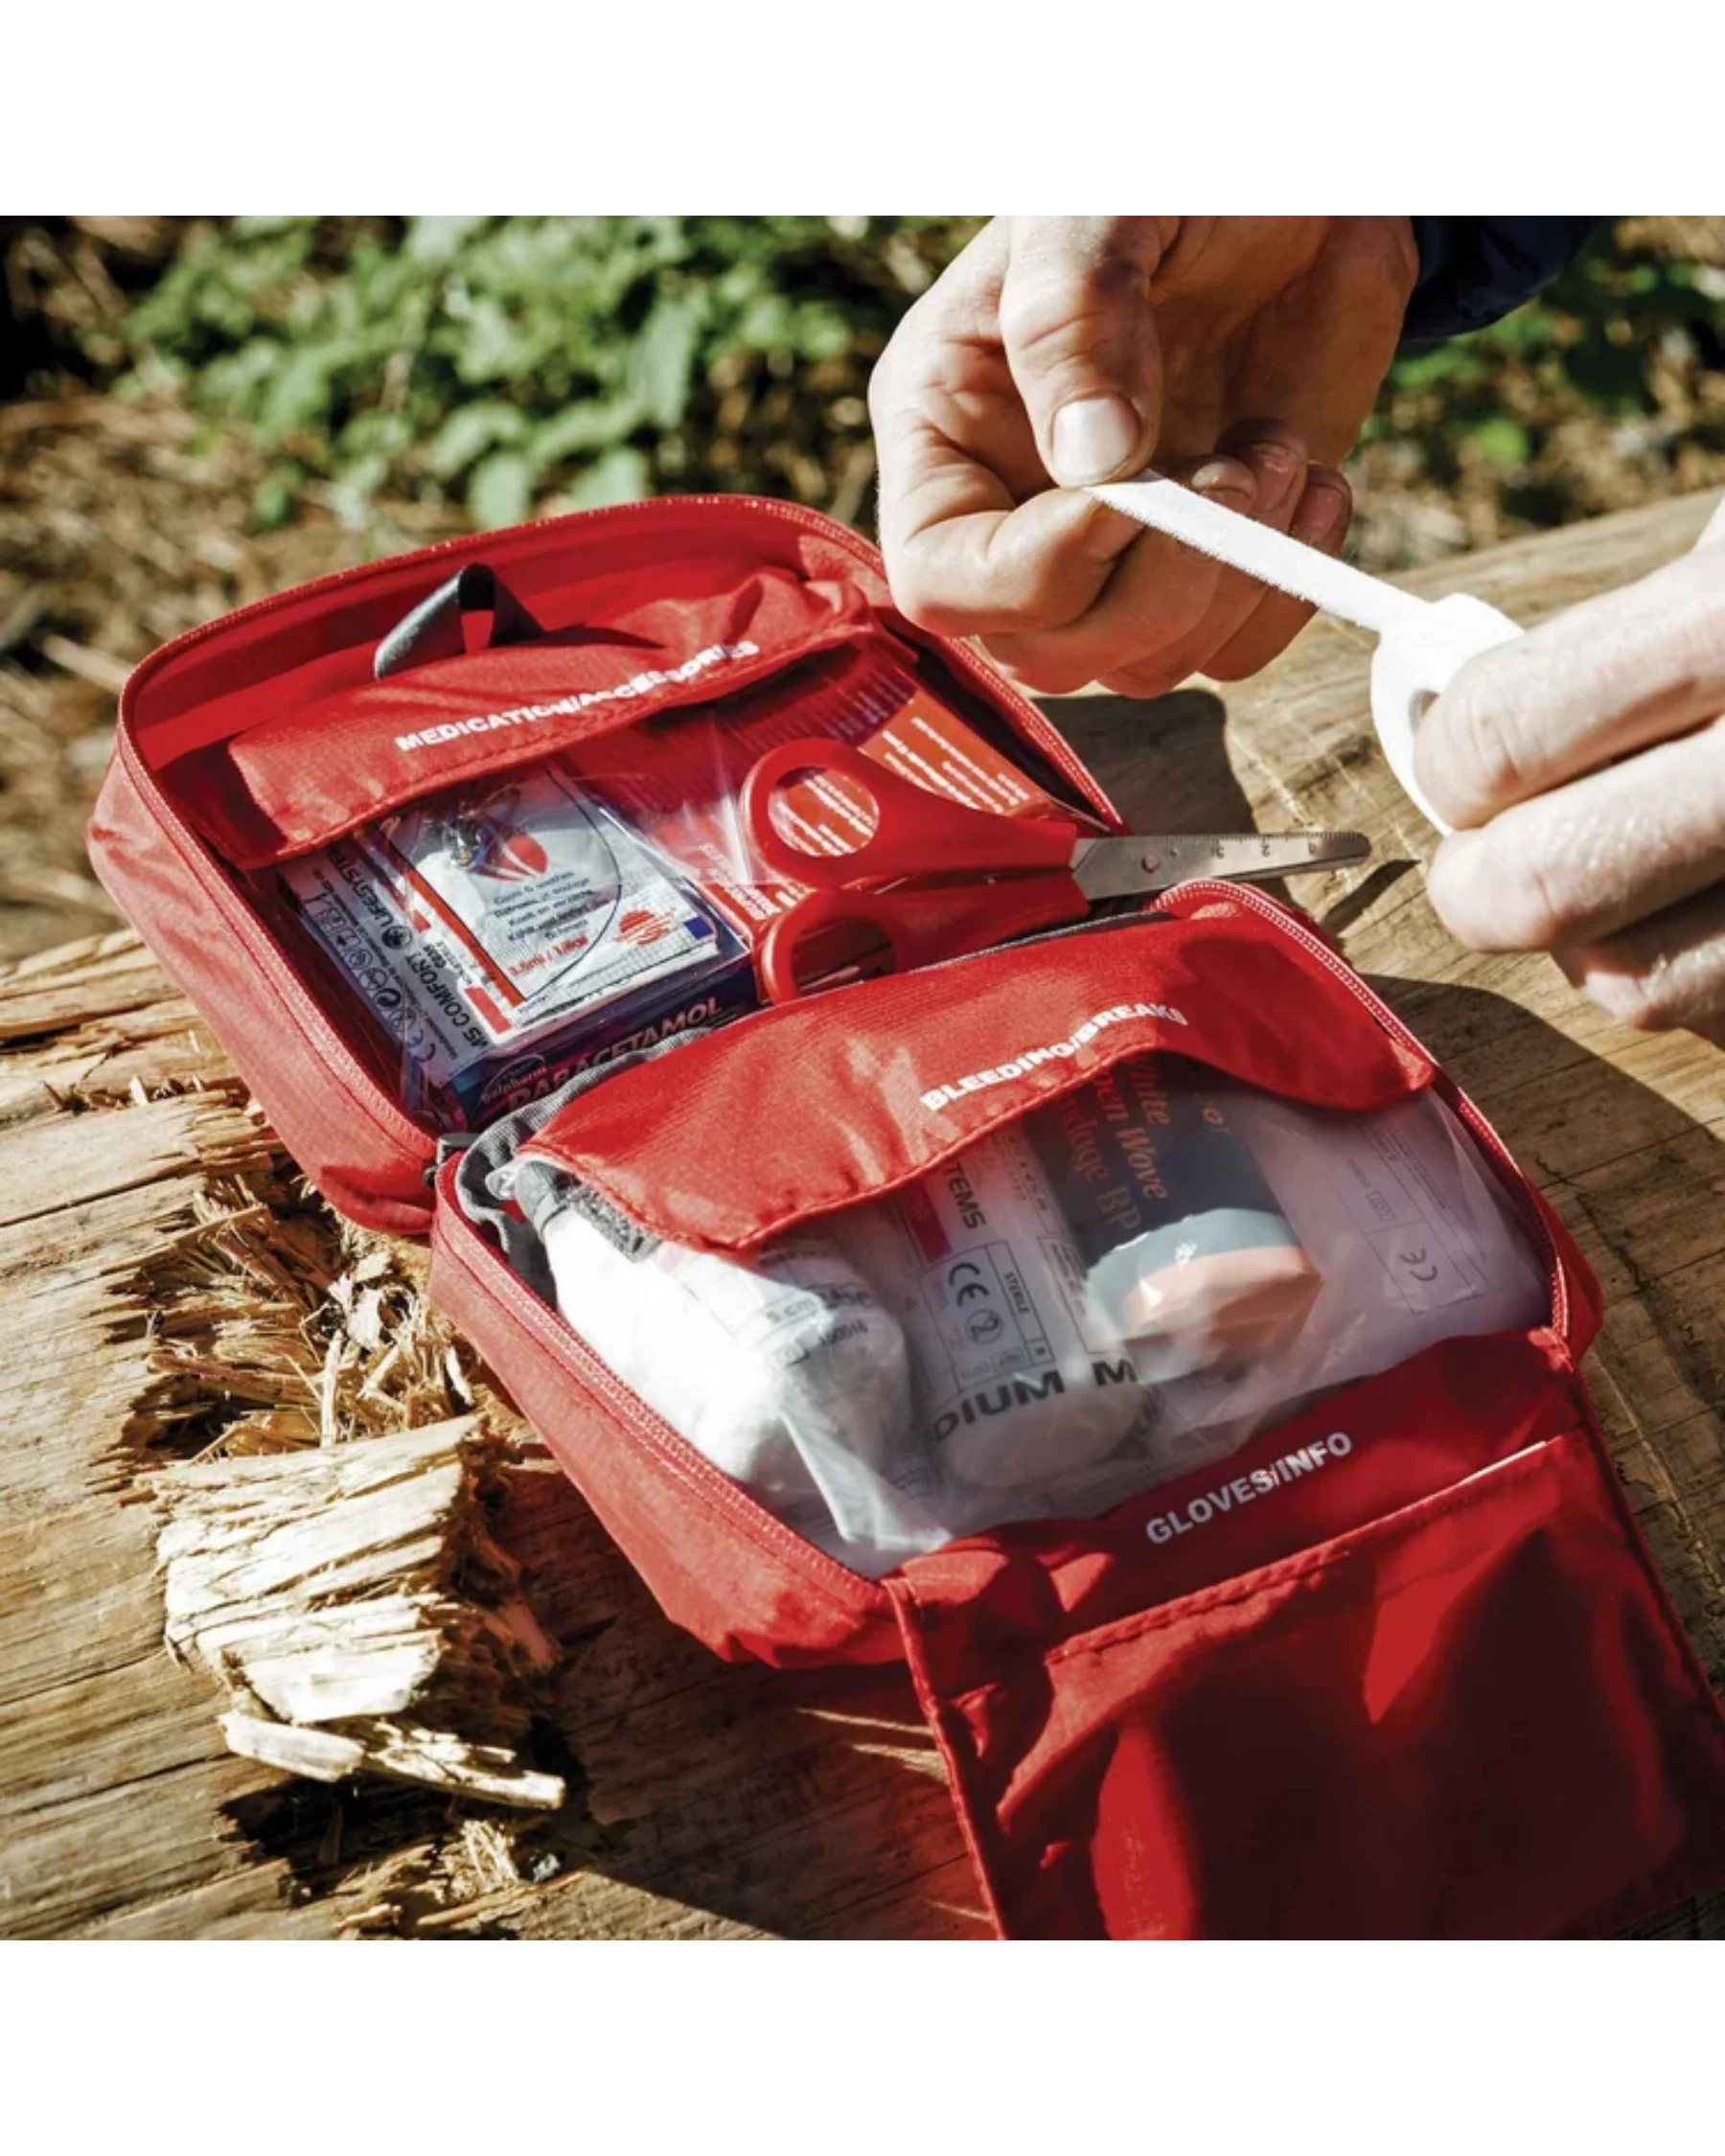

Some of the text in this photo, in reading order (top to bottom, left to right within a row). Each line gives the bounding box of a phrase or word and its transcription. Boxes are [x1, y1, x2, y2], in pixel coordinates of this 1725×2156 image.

[405, 953, 471, 1027] COMFORT
[920, 1002, 1188, 1112] BLEEDING/BREAKS
[1125, 1058, 1172, 1126] hite
[1115, 1127, 1168, 1199] Wove
[1096, 1185, 1140, 1228] BP
[1003, 1272, 1030, 1314] STERILE
[1145, 1432, 1353, 1544] GLOVES/INFO
